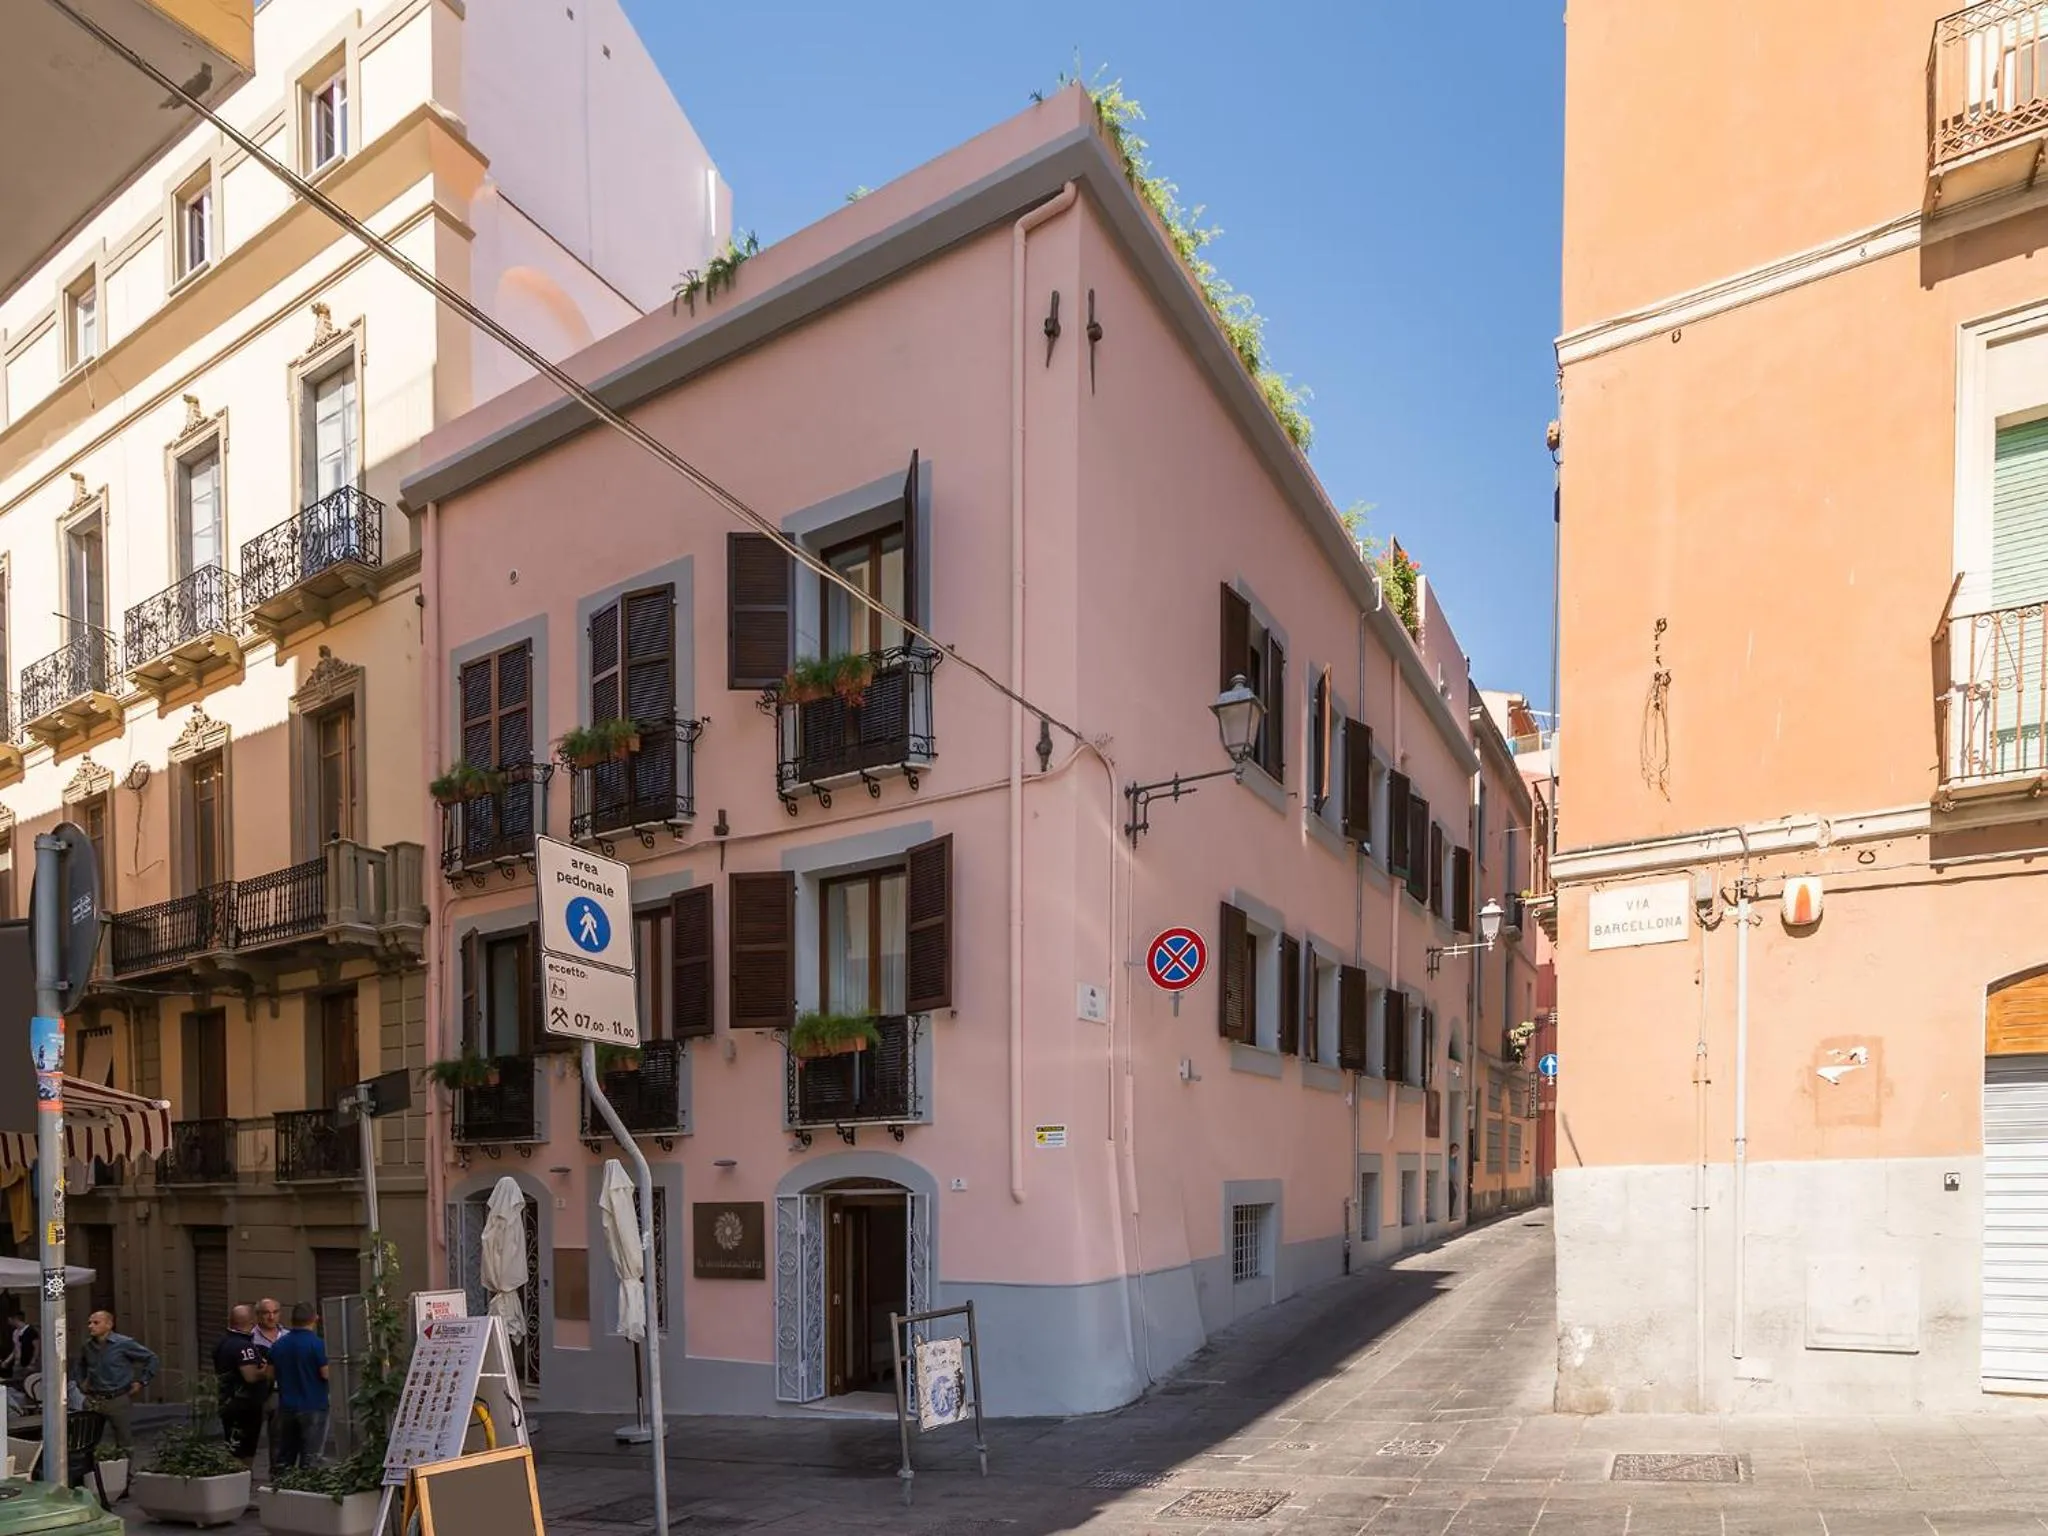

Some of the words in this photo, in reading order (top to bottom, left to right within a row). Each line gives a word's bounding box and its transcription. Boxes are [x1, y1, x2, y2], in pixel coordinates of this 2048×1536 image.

[571, 857, 598, 876] area
[556, 870, 614, 898] pedonale
[1626, 898, 1650, 911] VIA
[1594, 915, 1682, 936] BARCELLONA
